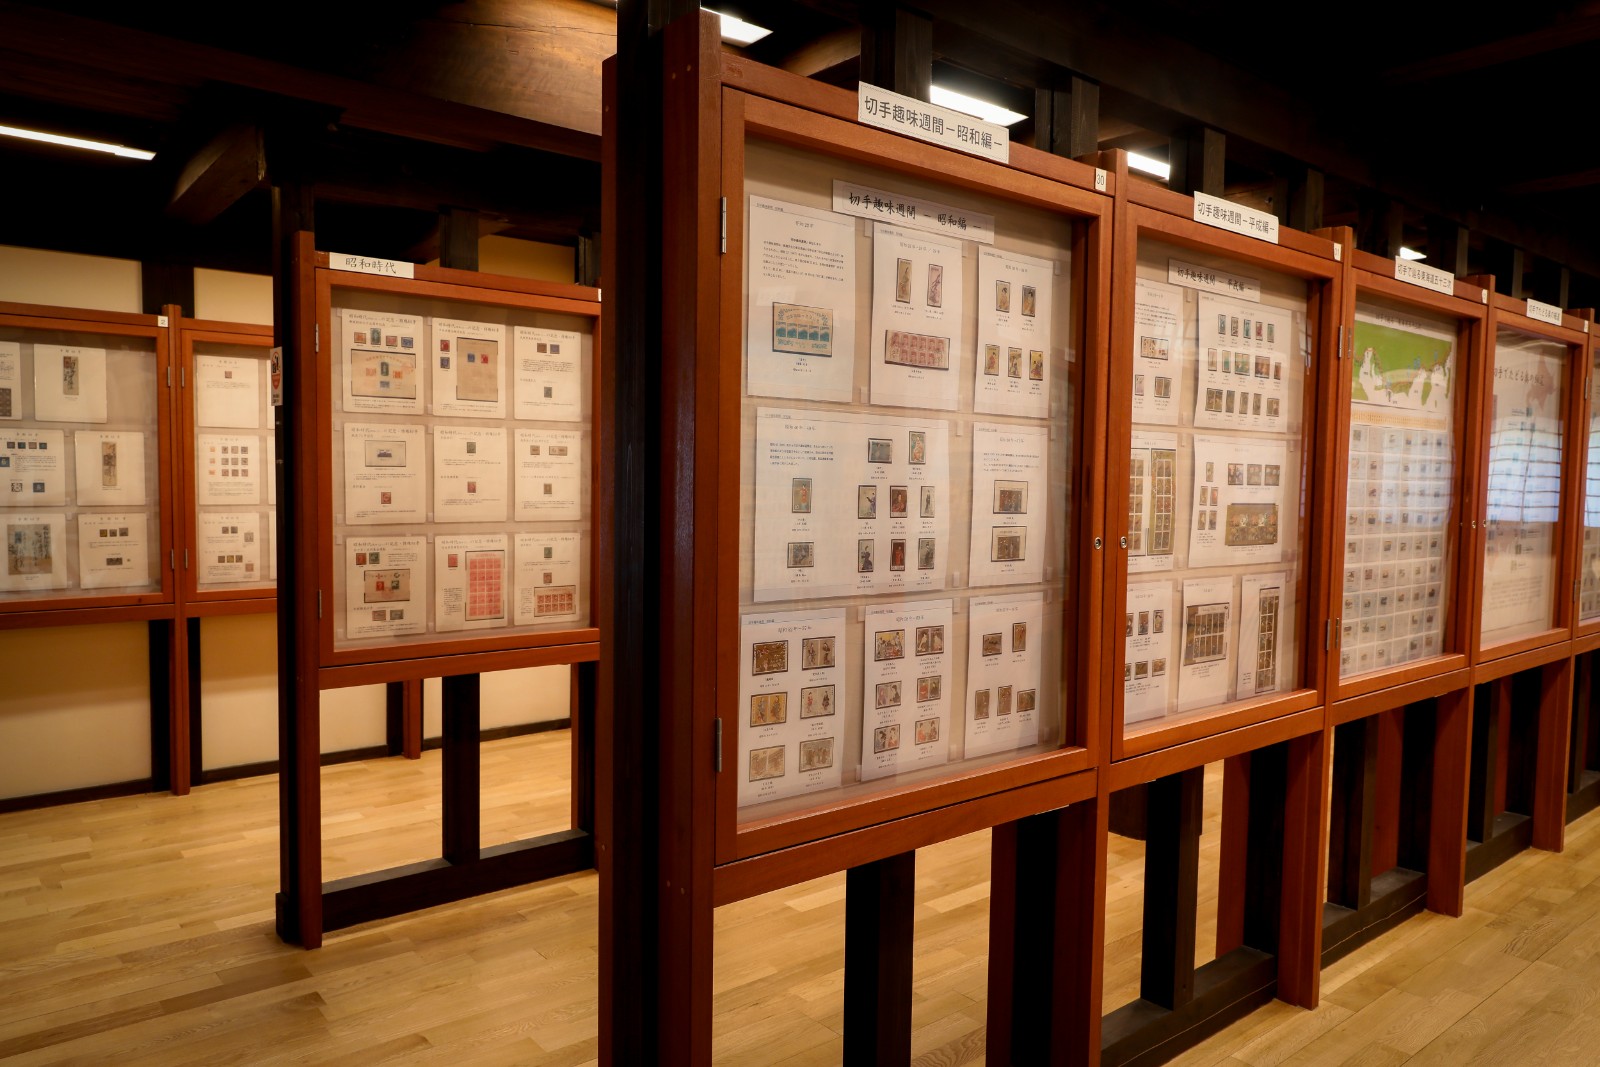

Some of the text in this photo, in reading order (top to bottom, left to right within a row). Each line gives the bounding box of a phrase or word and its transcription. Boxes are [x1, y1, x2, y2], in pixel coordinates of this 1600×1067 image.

[1096, 173, 1105, 186] 30
[345, 257, 397, 274] 昭和時代
